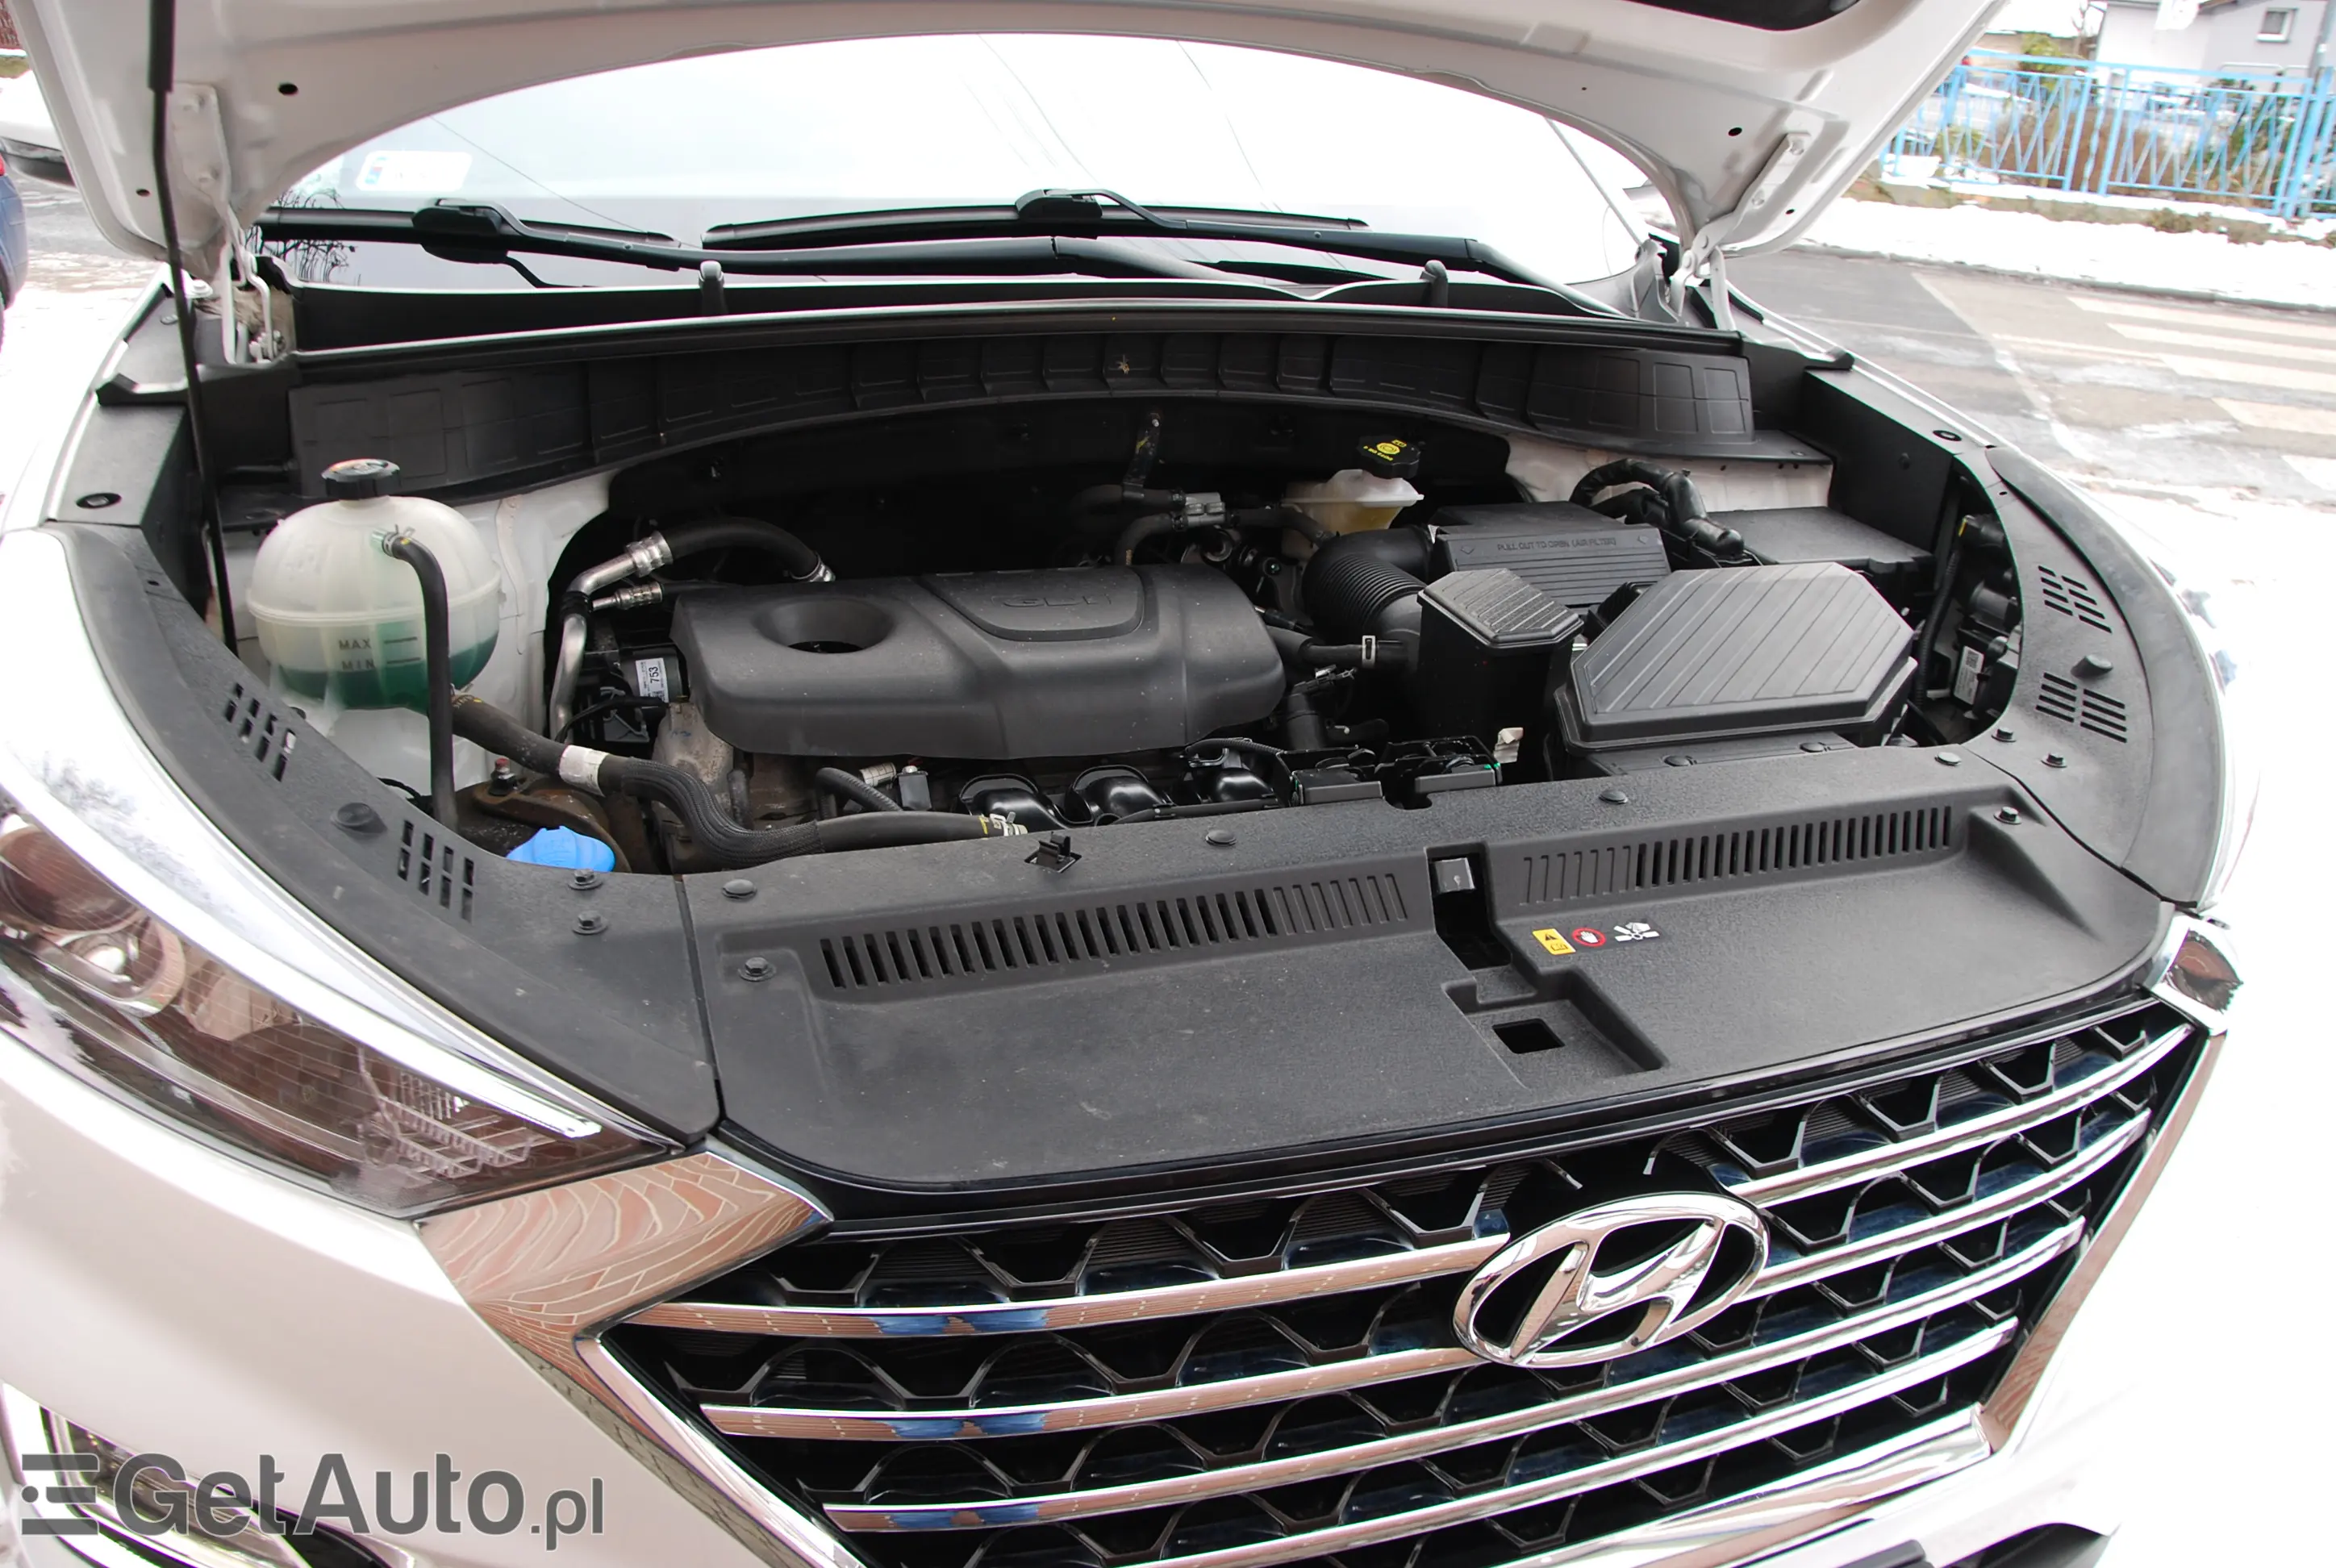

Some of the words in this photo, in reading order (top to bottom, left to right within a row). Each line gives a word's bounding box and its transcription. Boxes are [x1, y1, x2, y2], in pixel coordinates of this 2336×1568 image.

[339, 639, 372, 650] MAX
[342, 660, 375, 670] MIN
[649, 666, 660, 684] 753
